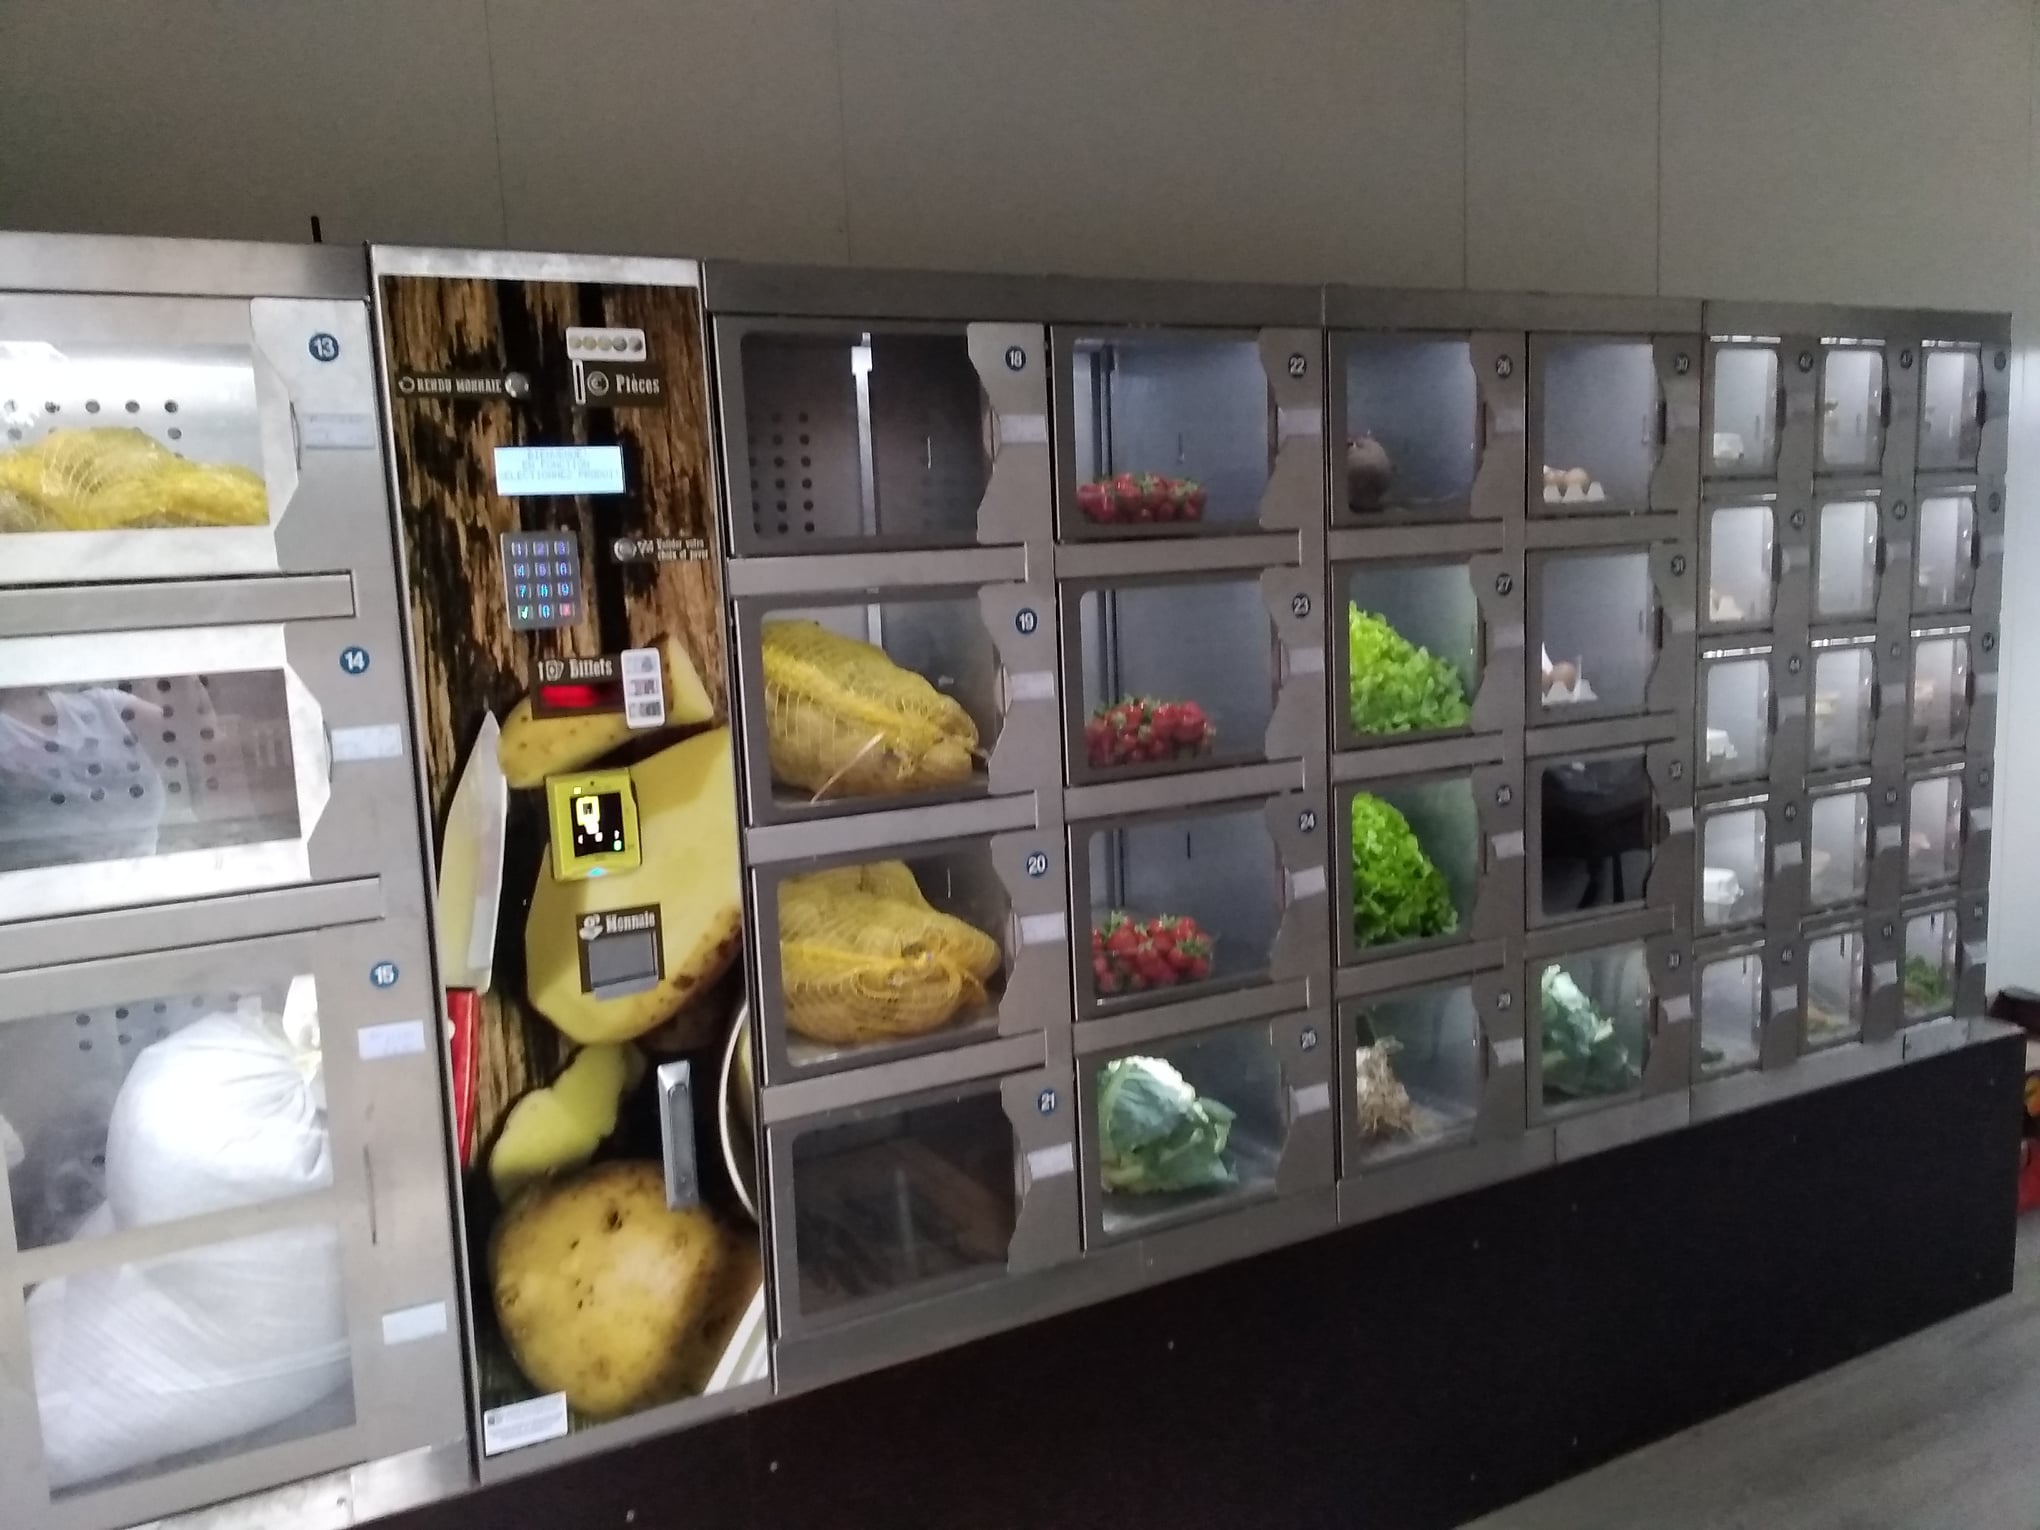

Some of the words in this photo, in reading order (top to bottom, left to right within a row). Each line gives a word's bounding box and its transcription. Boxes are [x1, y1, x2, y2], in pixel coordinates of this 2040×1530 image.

[313, 337, 335, 358] 13
[1009, 349, 1022, 368] 18
[1290, 356, 1305, 374] 22
[1498, 577, 1511, 592] 27
[1019, 611, 1035, 631] 19
[344, 650, 366, 671] 14
[569, 658, 613, 679] Billets
[1300, 812, 1315, 831] 24
[1028, 855, 1046, 875] 20
[605, 910, 656, 934] Monnaie
[1041, 1092, 1055, 1111] 21
